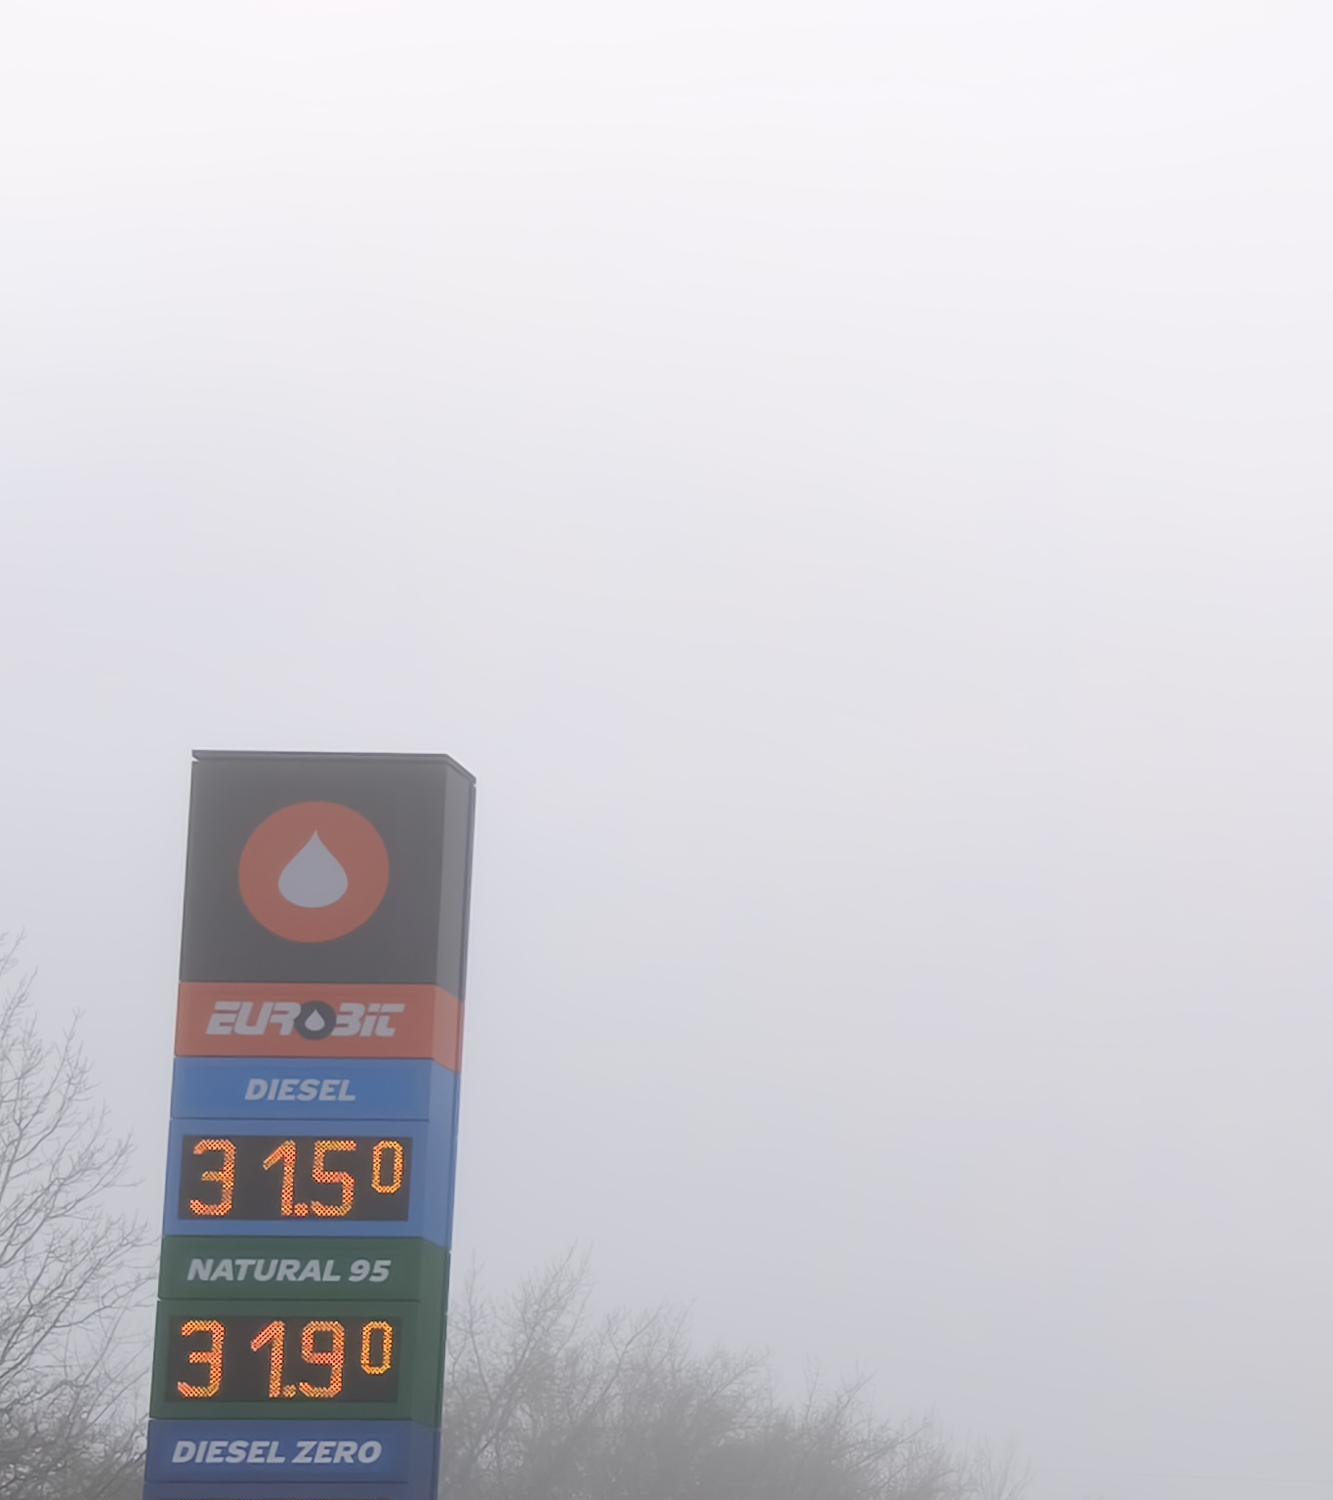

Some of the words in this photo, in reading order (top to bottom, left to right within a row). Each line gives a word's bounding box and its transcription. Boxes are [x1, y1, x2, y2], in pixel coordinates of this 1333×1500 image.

[245, 1078, 356, 1102] DIESEL
[187, 1259, 341, 1282] NATURAL
[349, 1259, 391, 1282] 95
[172, 1440, 286, 1464] DIESEL
[291, 1441, 382, 1464] ZERO
